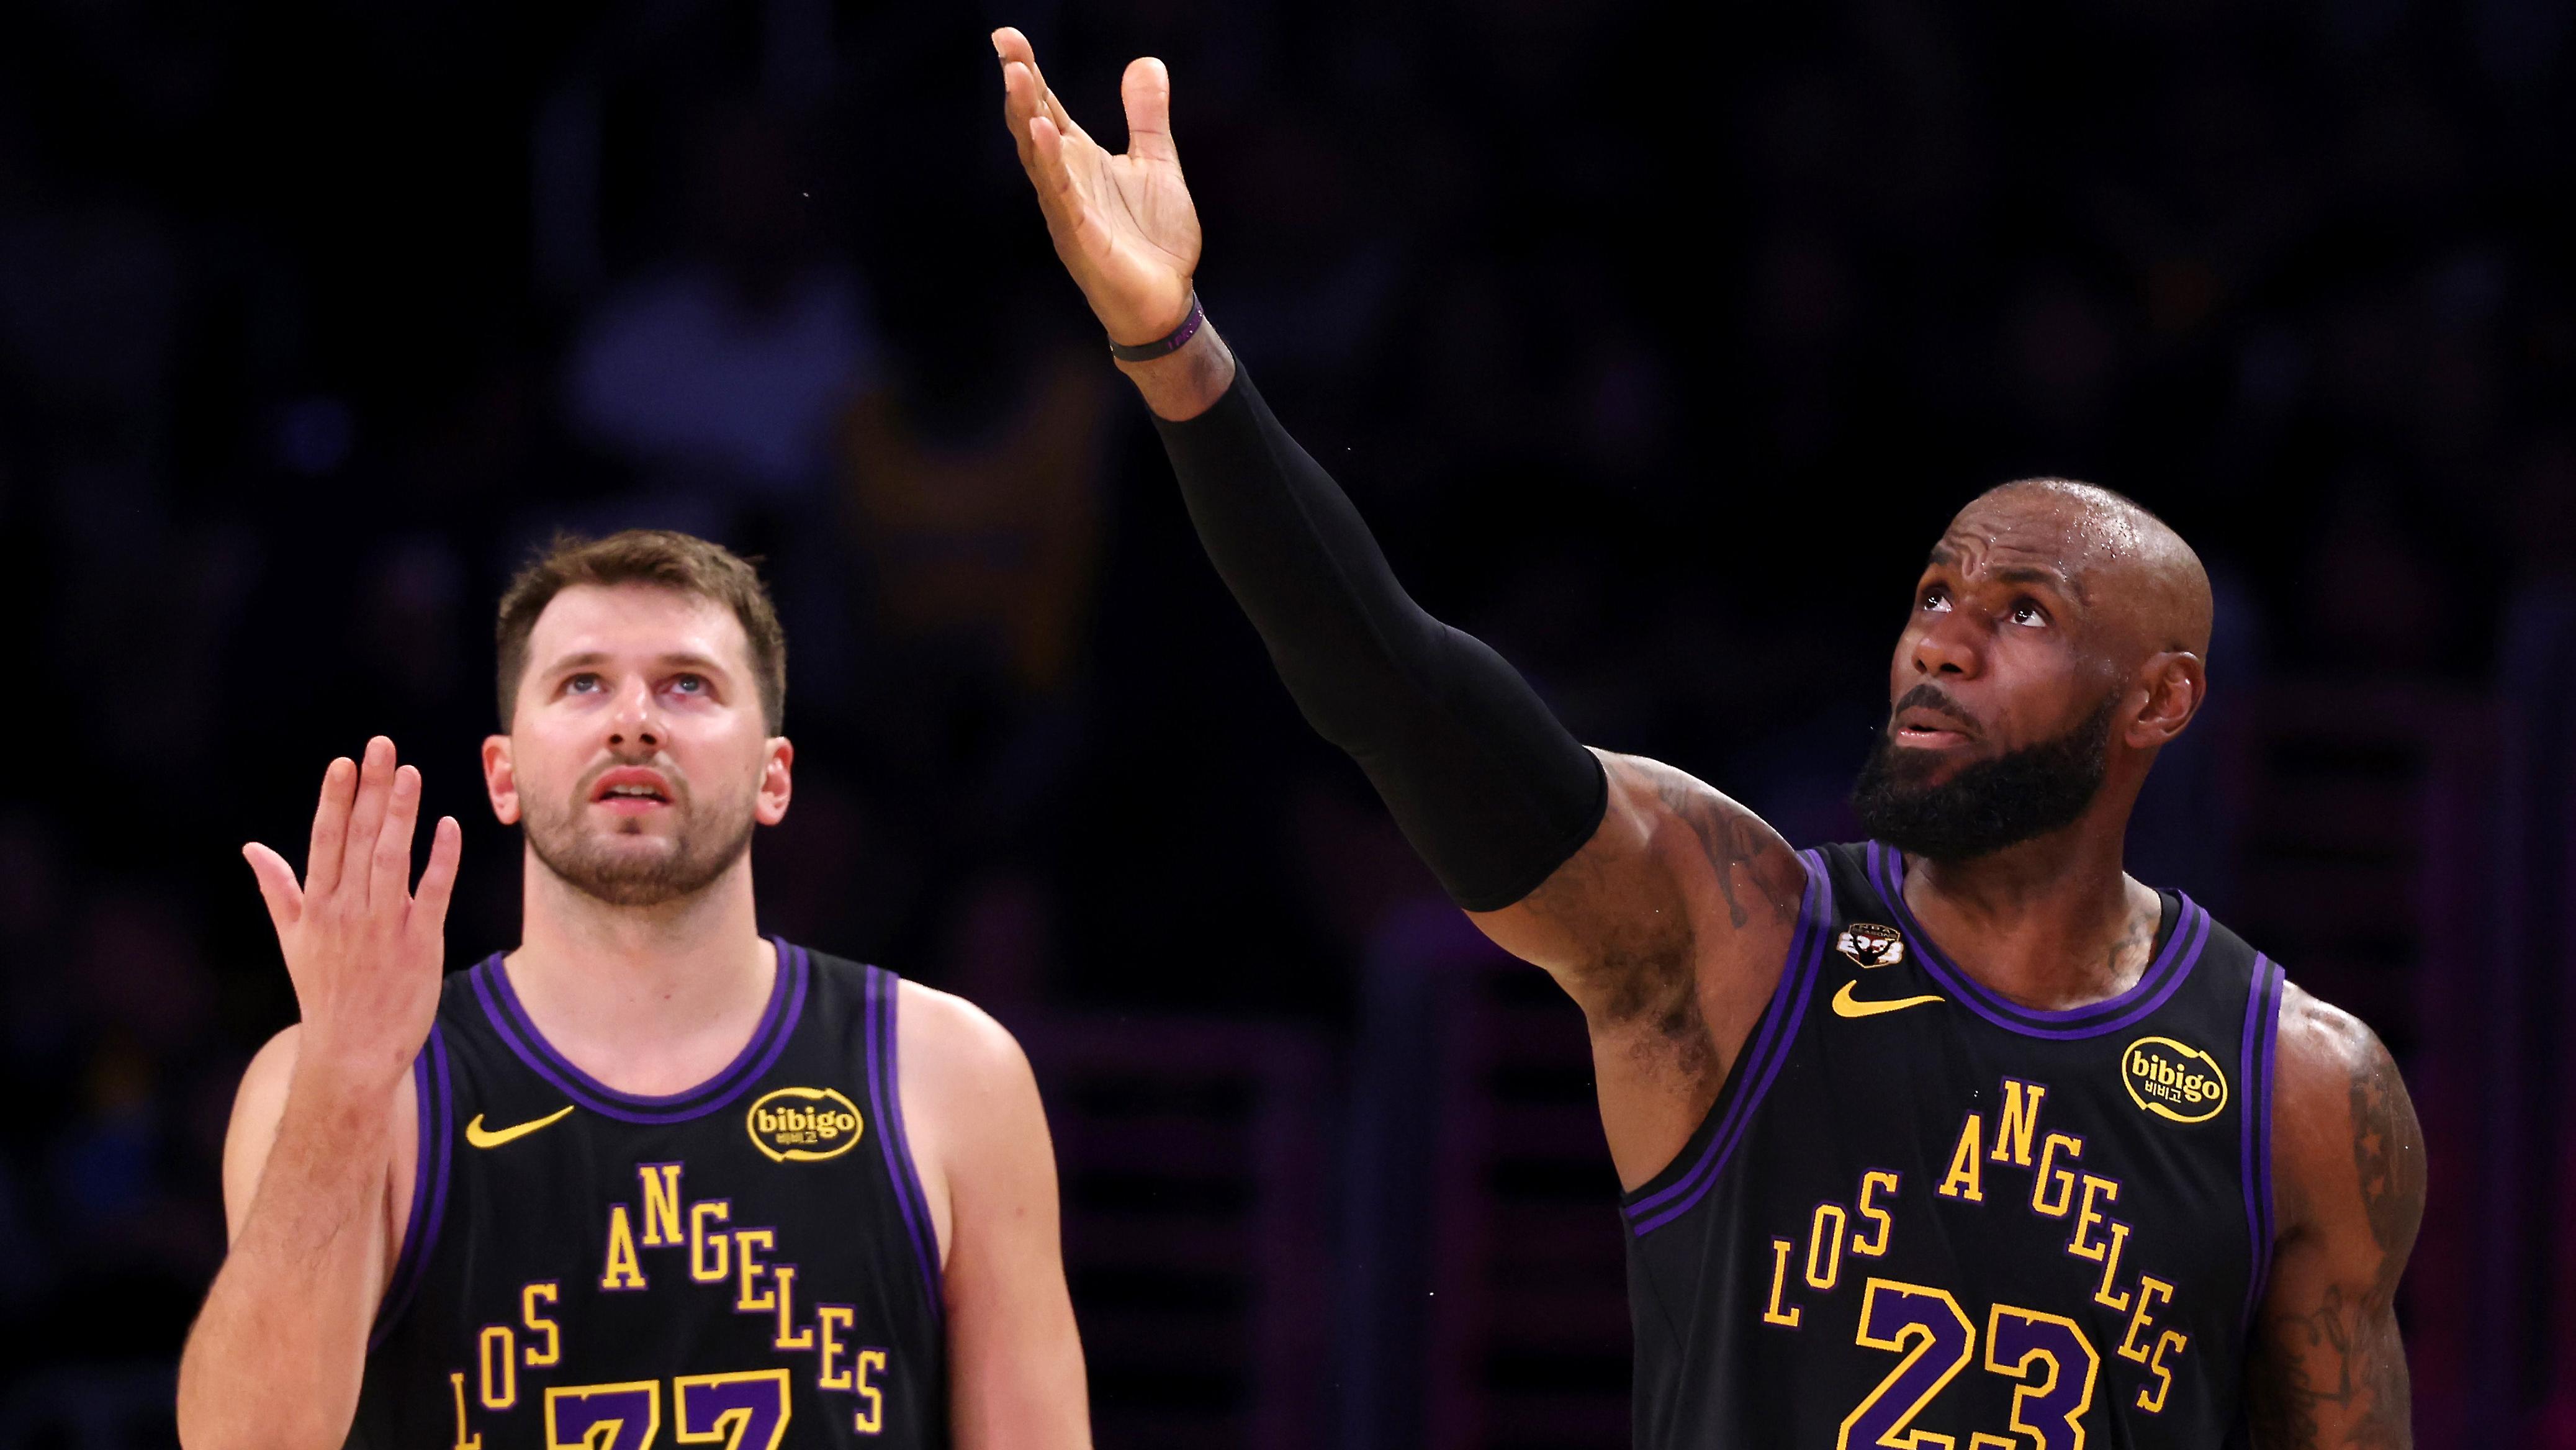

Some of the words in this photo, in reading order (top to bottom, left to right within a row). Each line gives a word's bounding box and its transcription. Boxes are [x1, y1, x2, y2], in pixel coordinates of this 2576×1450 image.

[757, 1106, 857, 1138] bibigo
[2132, 1050, 2221, 1103] bibigo
[2144, 1079, 2182, 1104] 비비고
[1762, 1170, 1899, 1328] LOS
[1937, 1079, 2189, 1414] ANGELES
[449, 1282, 562, 1450] LOS
[600, 1163, 888, 1434] ANGELES
[1835, 1276, 2102, 1450] 23
